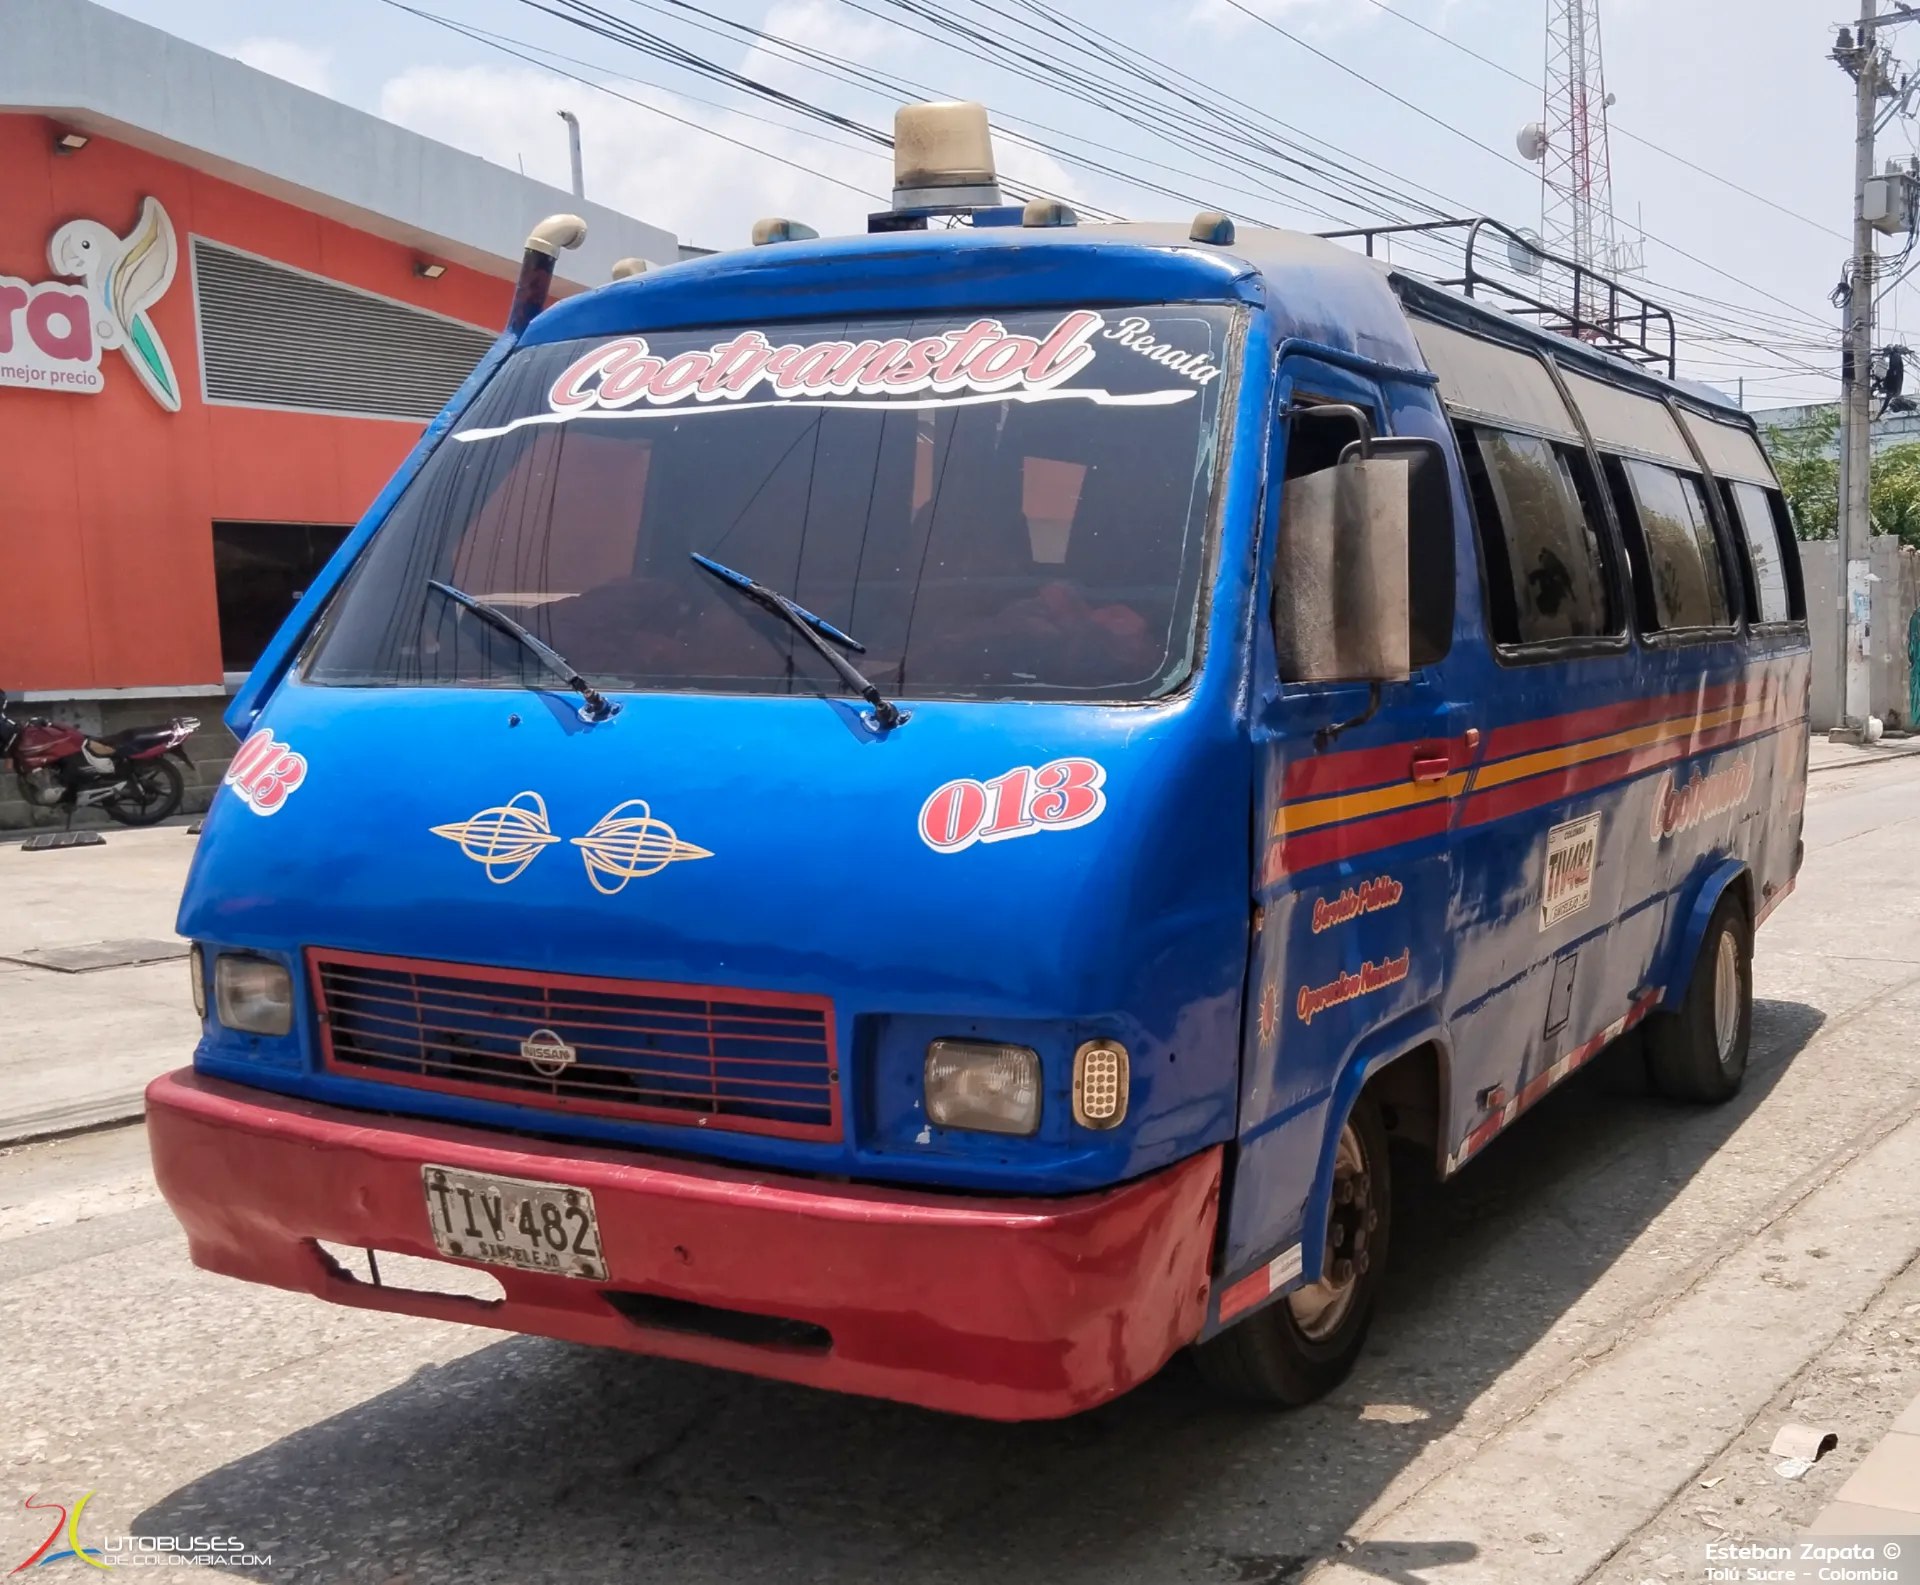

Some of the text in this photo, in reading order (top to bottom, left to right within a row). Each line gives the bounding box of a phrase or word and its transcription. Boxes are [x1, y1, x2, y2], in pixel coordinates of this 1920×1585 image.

[1, 364, 97, 385] mejor precio
[549, 309, 1104, 413] Cootranstol
[1103, 317, 1222, 385] Renata
[225, 728, 308, 816] 013
[918, 757, 1107, 854] 013
[524, 1046, 570, 1060] NISSAN
